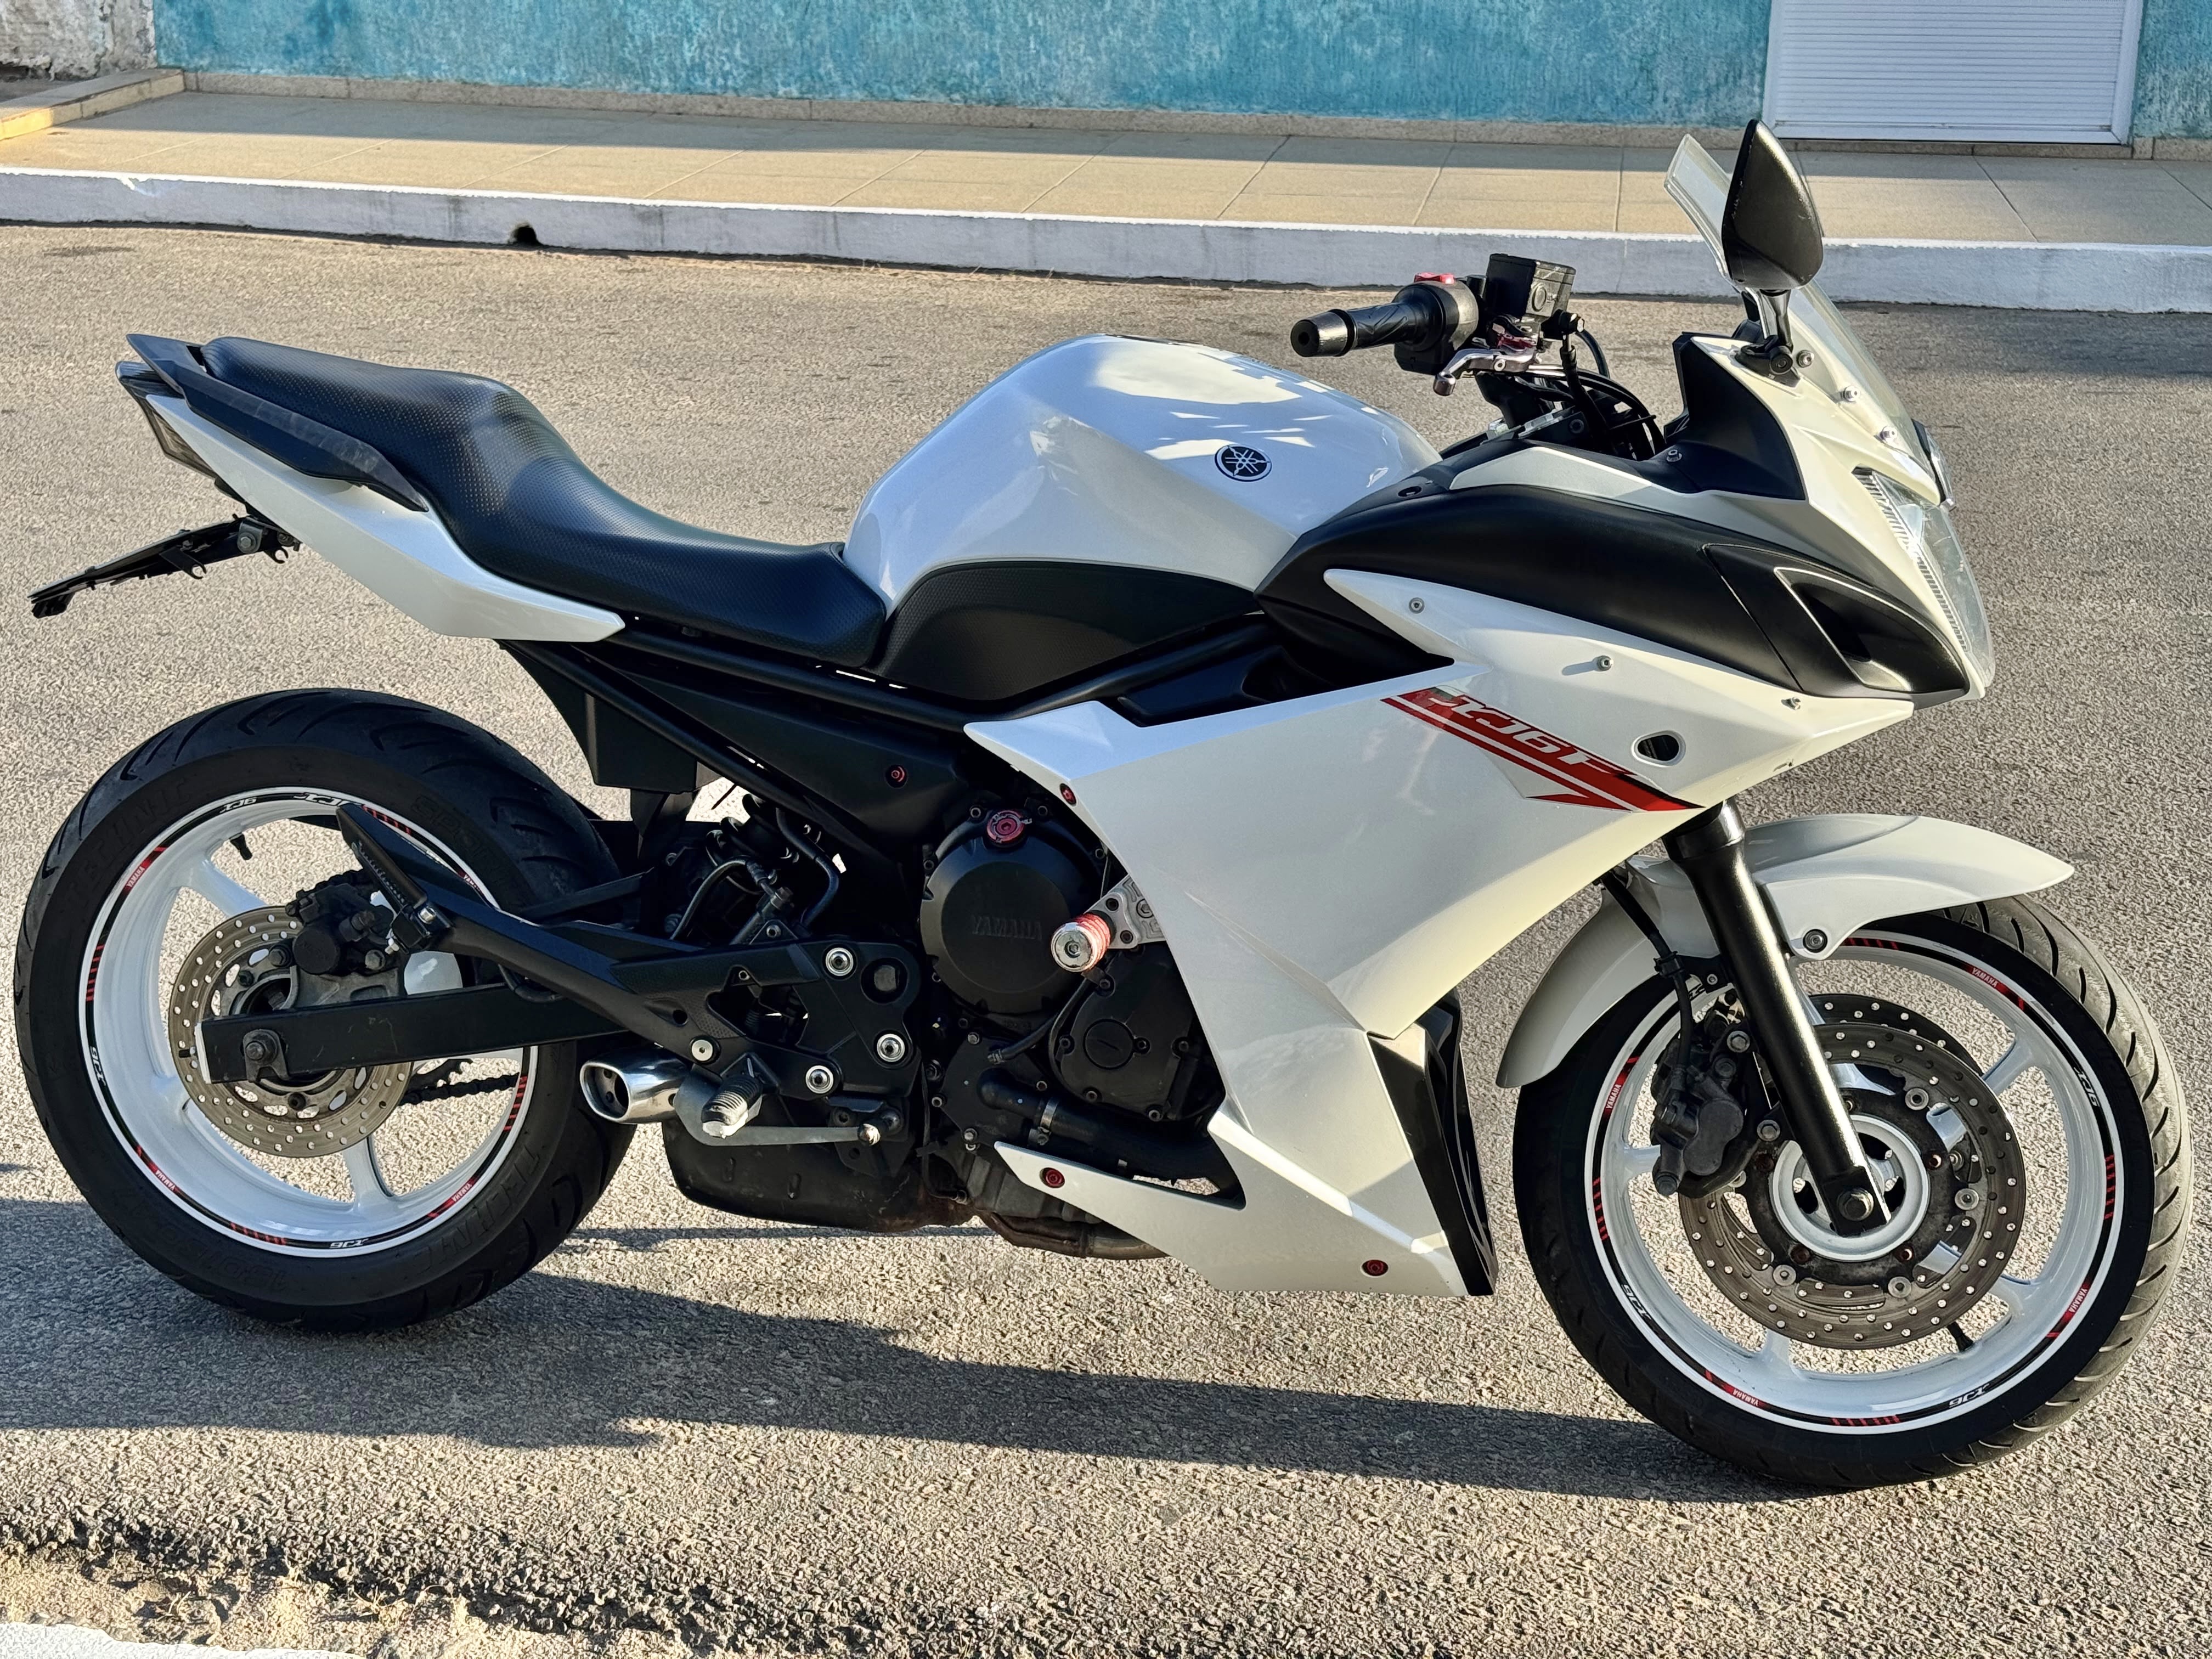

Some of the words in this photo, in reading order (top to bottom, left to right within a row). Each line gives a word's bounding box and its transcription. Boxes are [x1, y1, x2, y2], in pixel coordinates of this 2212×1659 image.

[220, 796, 257, 813] XJ6
[126, 865, 145, 886] YAMAHA
[970, 915, 1043, 941] YAMAHA
[1972, 967, 1999, 988] YAMAHA
[89, 1046, 106, 1085] XJ6
[1606, 1084, 1621, 1108] YAMAHA
[2073, 1068, 2100, 1107] XJ6
[155, 1170, 174, 1190] YAMAHA
[451, 1183, 472, 1201] YAMAHA
[329, 1238, 368, 1248] XJ6
[1621, 1284, 1651, 1319] XJ6
[2068, 1288, 2087, 1313] YAMAHA
[1732, 1389, 1757, 1406] YAMAHA
[1949, 1384, 1989, 1408] XJ6
